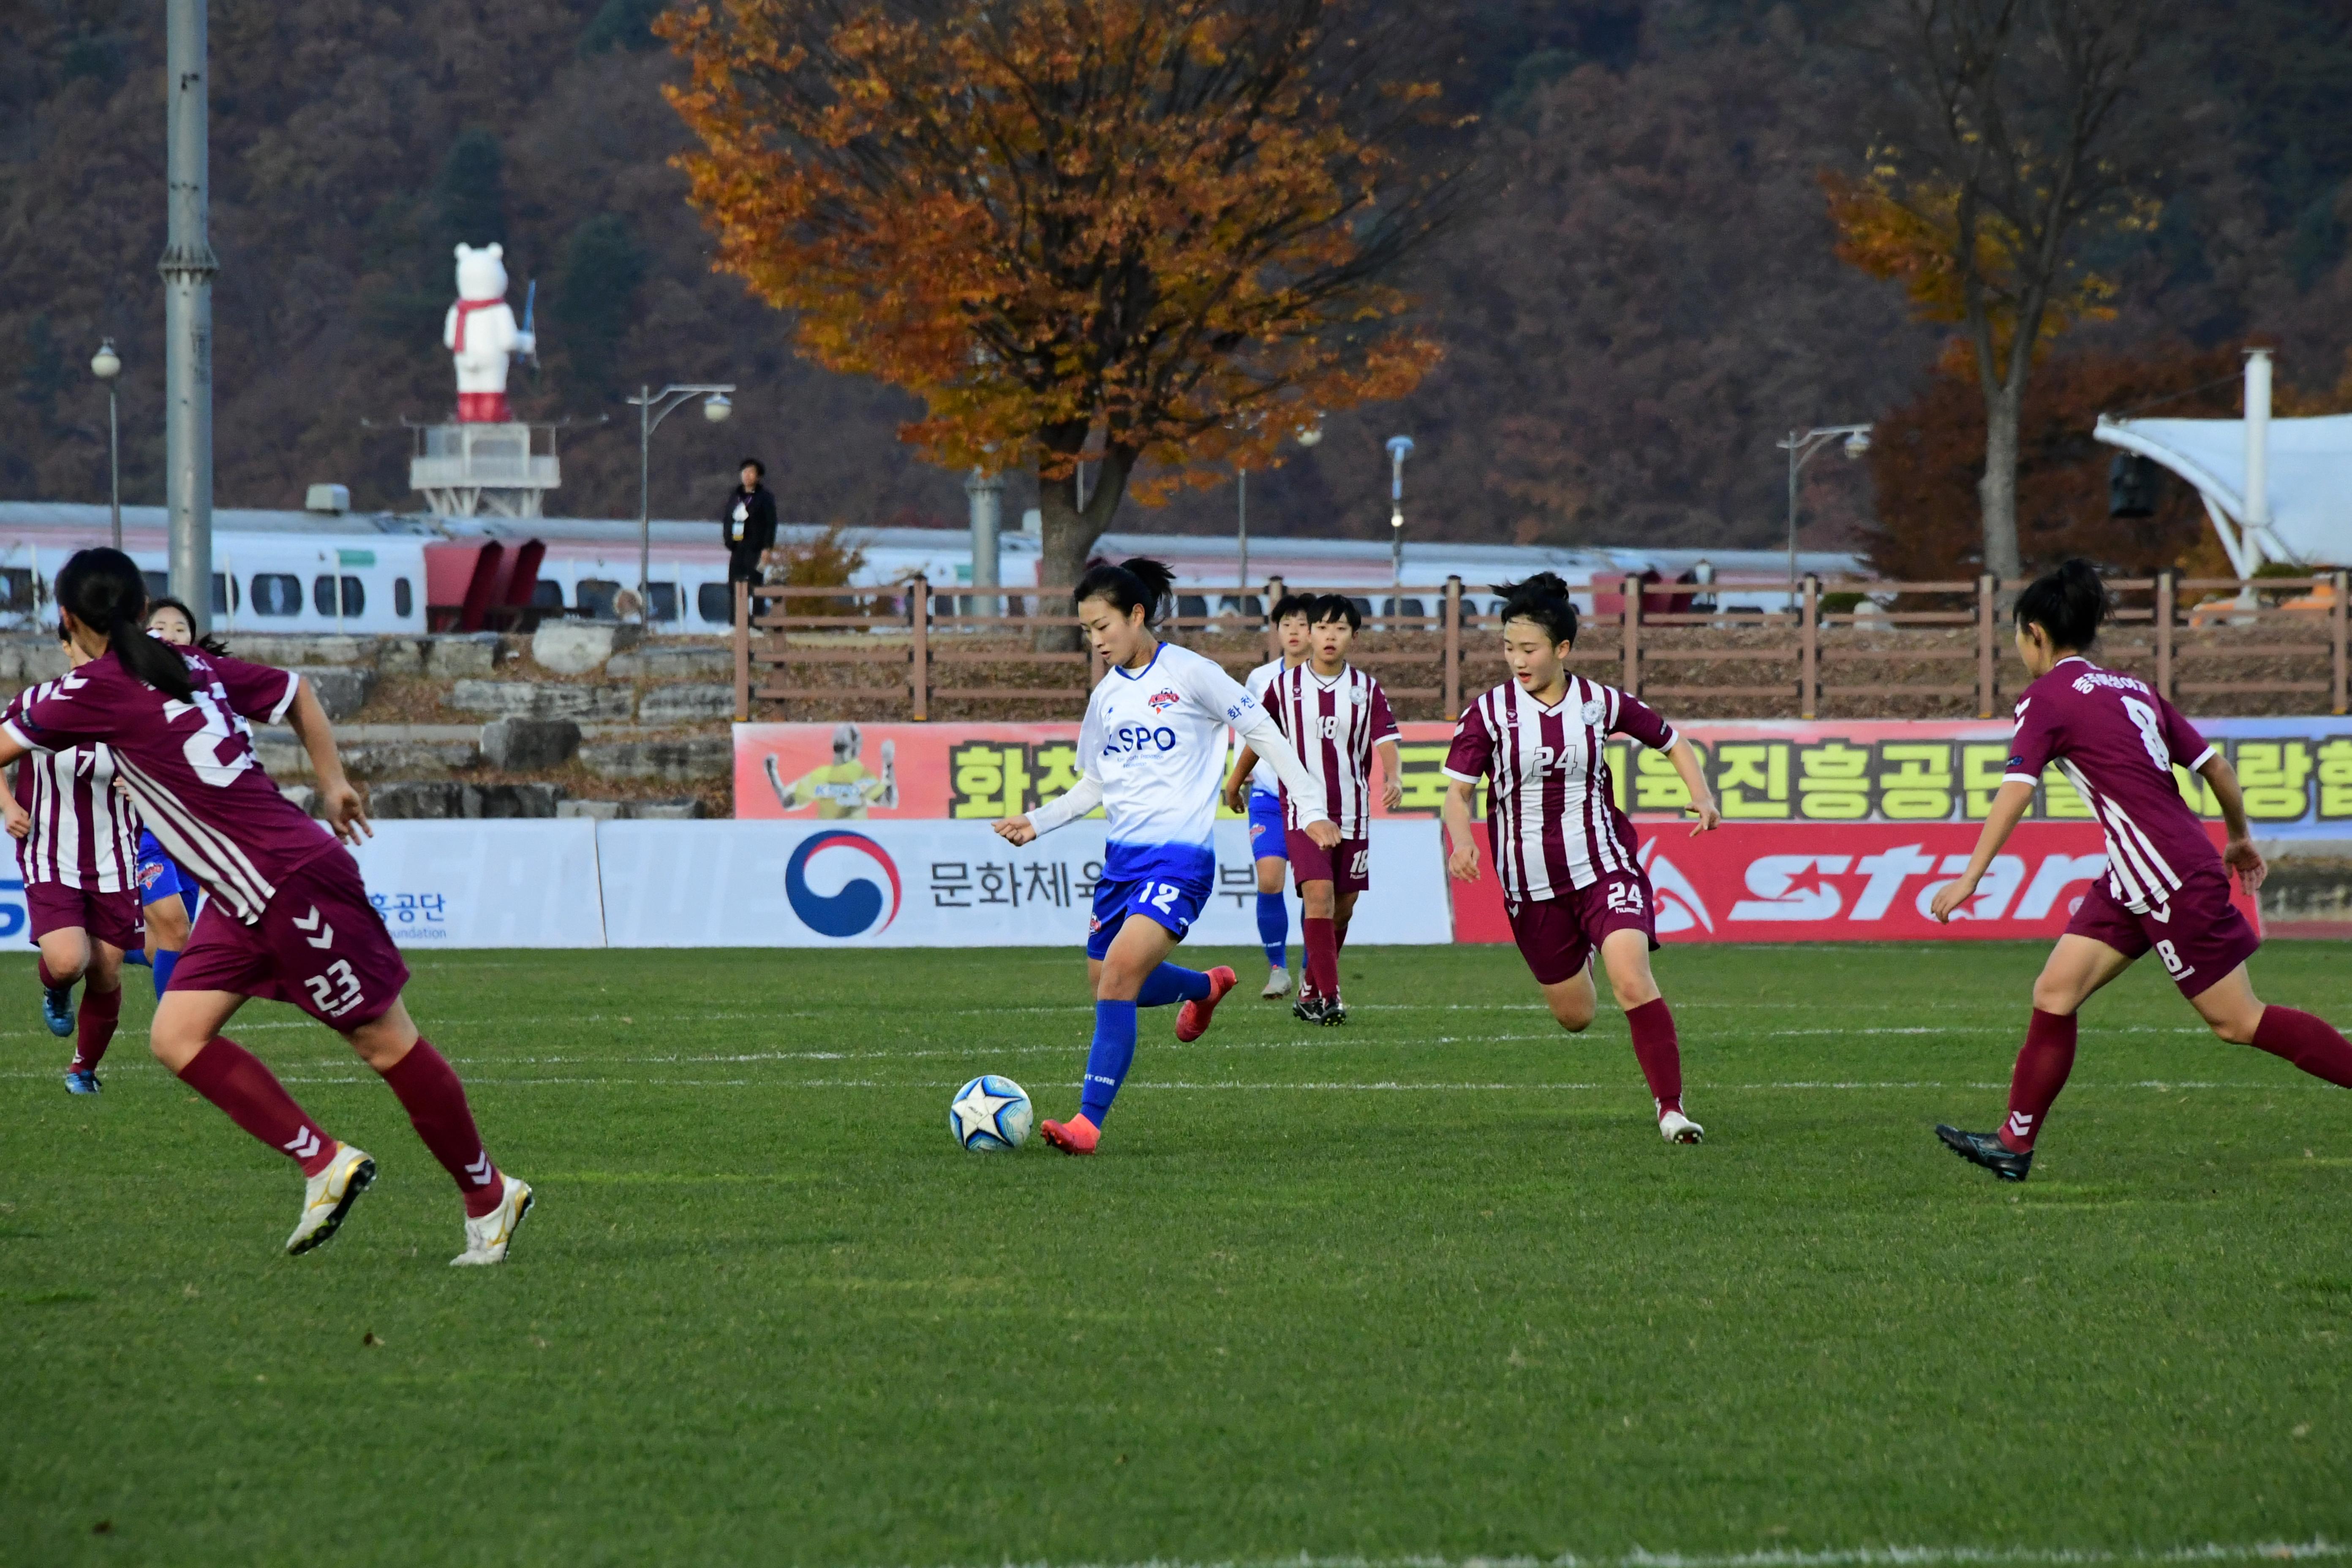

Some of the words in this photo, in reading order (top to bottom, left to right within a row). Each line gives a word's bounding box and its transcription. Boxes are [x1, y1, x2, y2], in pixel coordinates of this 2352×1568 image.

[1316, 716, 1339, 739] 18
[2120, 695, 2172, 771] 8
[1532, 745, 1578, 777] 24
[1350, 849, 1368, 874] 18
[931, 861, 1257, 908] 문화체육부
[1139, 882, 1180, 915] 12
[1607, 881, 1643, 910] 24
[2156, 939, 2183, 973] 8
[304, 959, 361, 1011] 23
